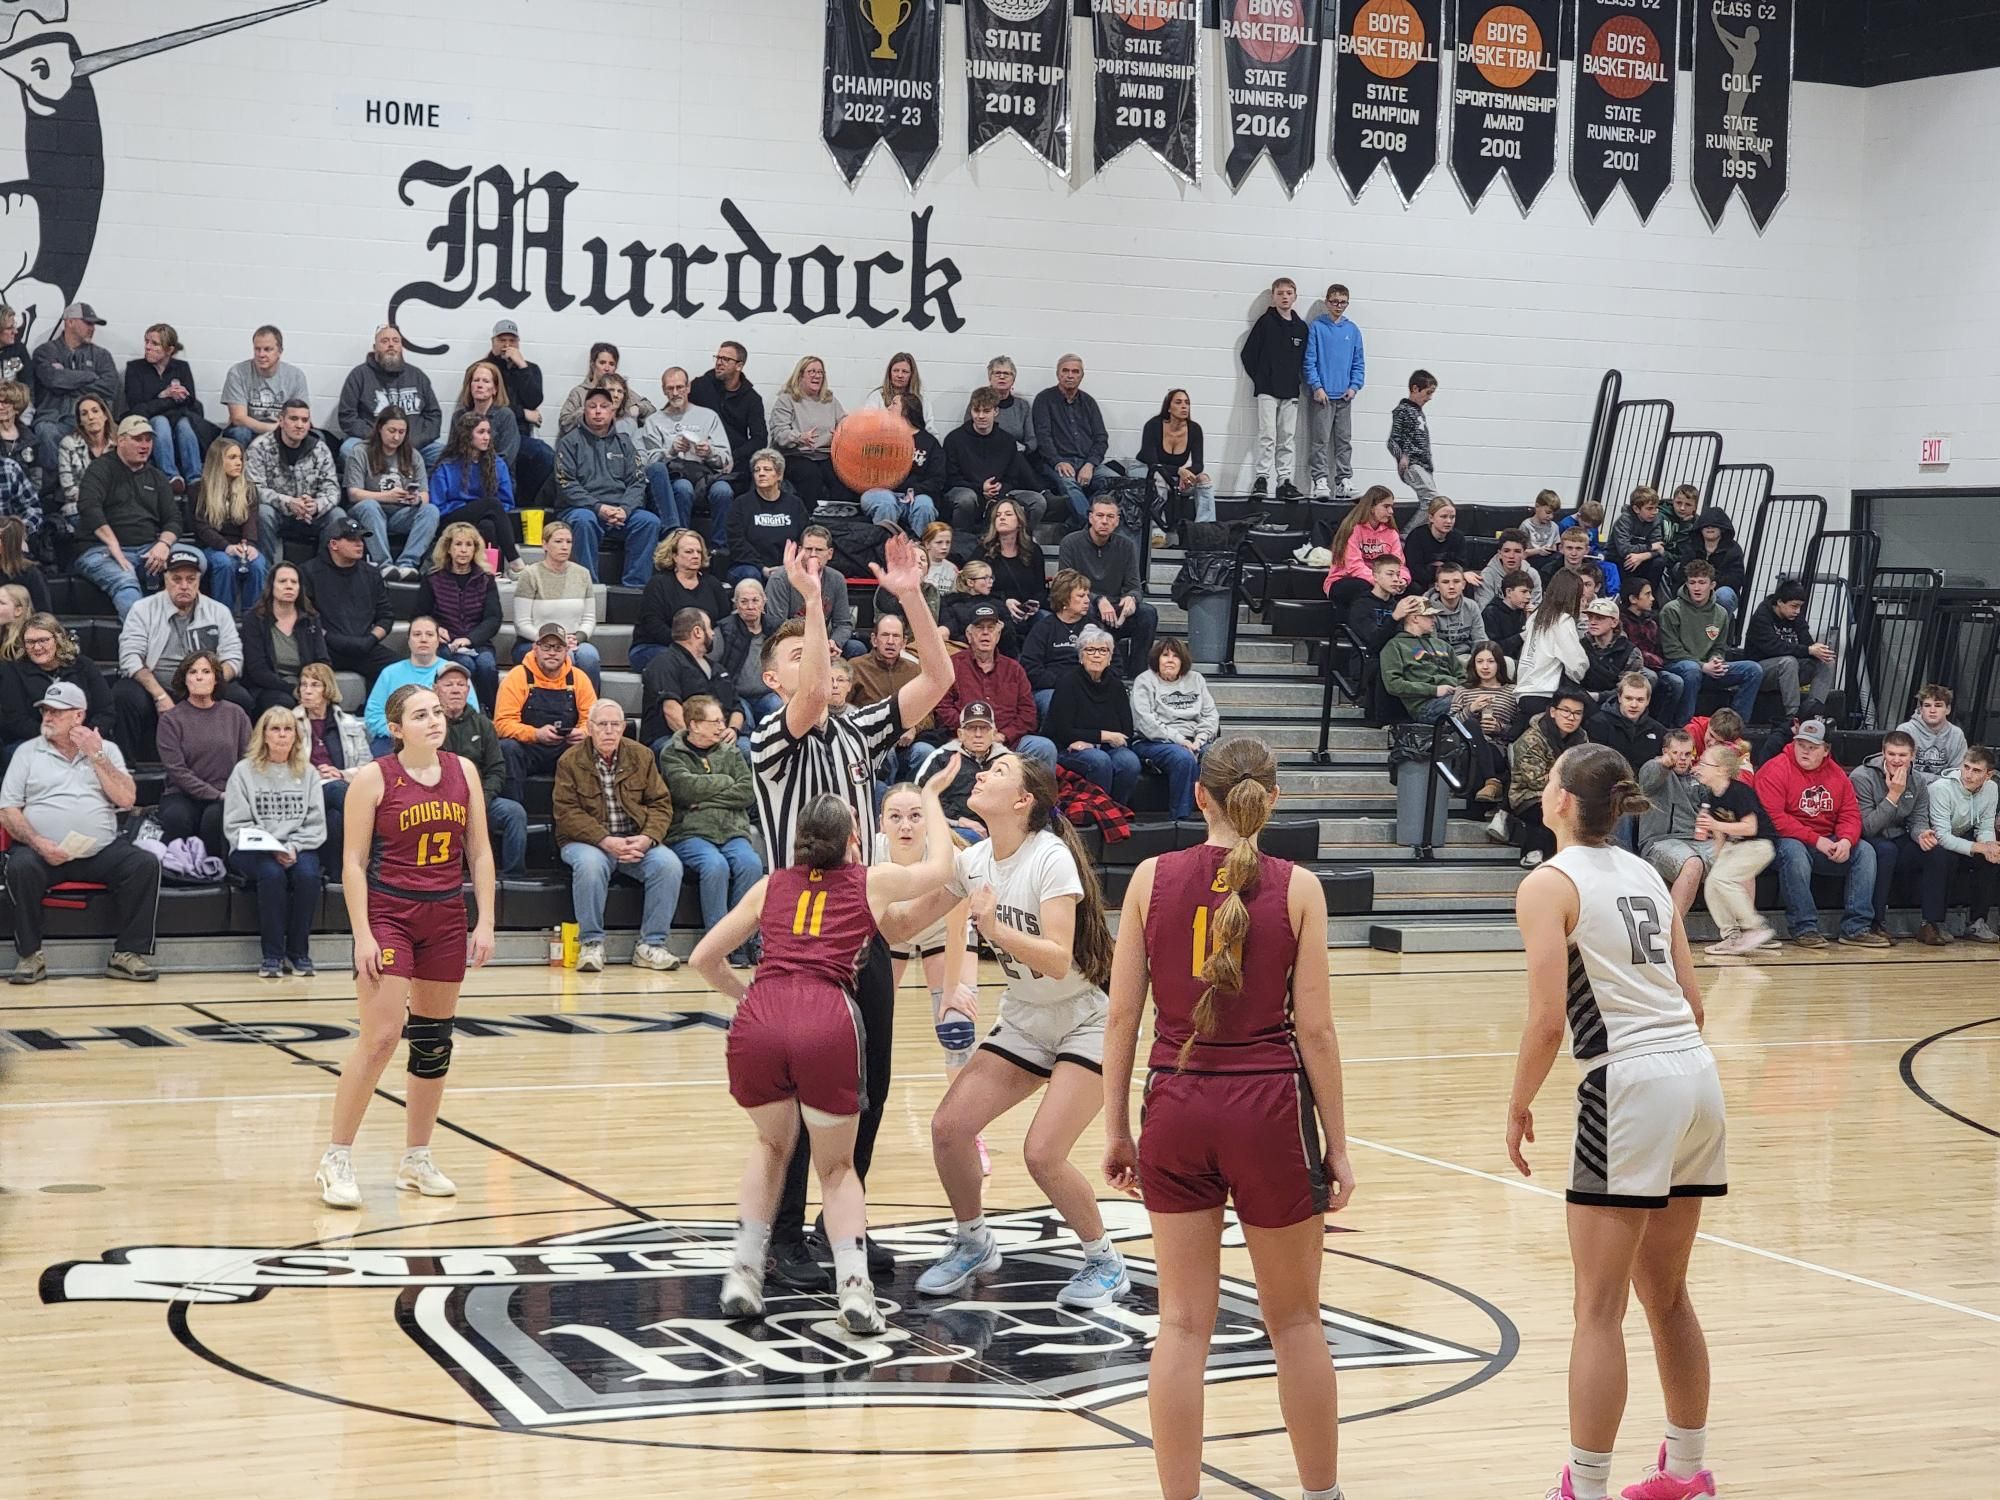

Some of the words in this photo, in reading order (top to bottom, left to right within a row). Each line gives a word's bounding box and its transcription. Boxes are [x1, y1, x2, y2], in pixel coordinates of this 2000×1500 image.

[1092, 0, 1196, 21] BASKETBALL
[1249, 0, 1293, 18] BOYS
[1713, 0, 1751, 18] CLASS
[1757, 4, 1776, 20] C-2
[1223, 19, 1317, 46] BASKETBALL
[1368, 12, 1410, 35] BOYS
[1487, 22, 1527, 45] BOYS
[985, 28, 1042, 52] STATE
[1125, 38, 1162, 55] STATE
[1338, 34, 1438, 62] BASKETBALL
[1606, 32, 1646, 55] BOYS
[1458, 42, 1556, 72] BASKETBALL
[1583, 54, 1669, 83] BASKETBALL
[966, 58, 1064, 86] RUNNER-UP
[1094, 57, 1194, 81] SPORTSMANSHIP
[1245, 69, 1287, 88] STATE
[832, 74, 932, 100] CHAMPIONS
[1119, 82, 1164, 101] AWARD
[1366, 83, 1408, 103] STATE
[1721, 73, 1763, 93] GOLF
[985, 92, 1036, 116] 2018
[1228, 87, 1307, 110] RUNNER-UP
[1455, 88, 1556, 113] SPORTSMANSHIP
[366, 99, 440, 128] HOME
[844, 102, 884, 123] 2022
[901, 106, 921, 126] 23
[1116, 106, 1166, 129] 2018
[1352, 103, 1419, 126] CHAMPION
[1483, 113, 1524, 132] AWARD
[1604, 105, 1642, 123] STATE
[1723, 116, 1758, 133] STATE
[1236, 113, 1291, 138] 2016
[1587, 123, 1657, 145] RUNNER-UP
[1360, 129, 1407, 152] 2008
[1480, 137, 1522, 160] 2001
[1705, 134, 1773, 153] RUNNER-UP
[1603, 150, 1640, 172] 2001
[1722, 158, 1757, 180] 1995
[388, 159, 966, 356] Murdock
[1922, 439, 1941, 462] EXIT
[754, 513, 791, 527] KNIGHTS
[400, 801, 466, 832] COUGARS
[416, 831, 452, 867] 13
[793, 889, 827, 937] 11
[994, 904, 1041, 936] GHTS
[1616, 896, 1666, 964] 12
